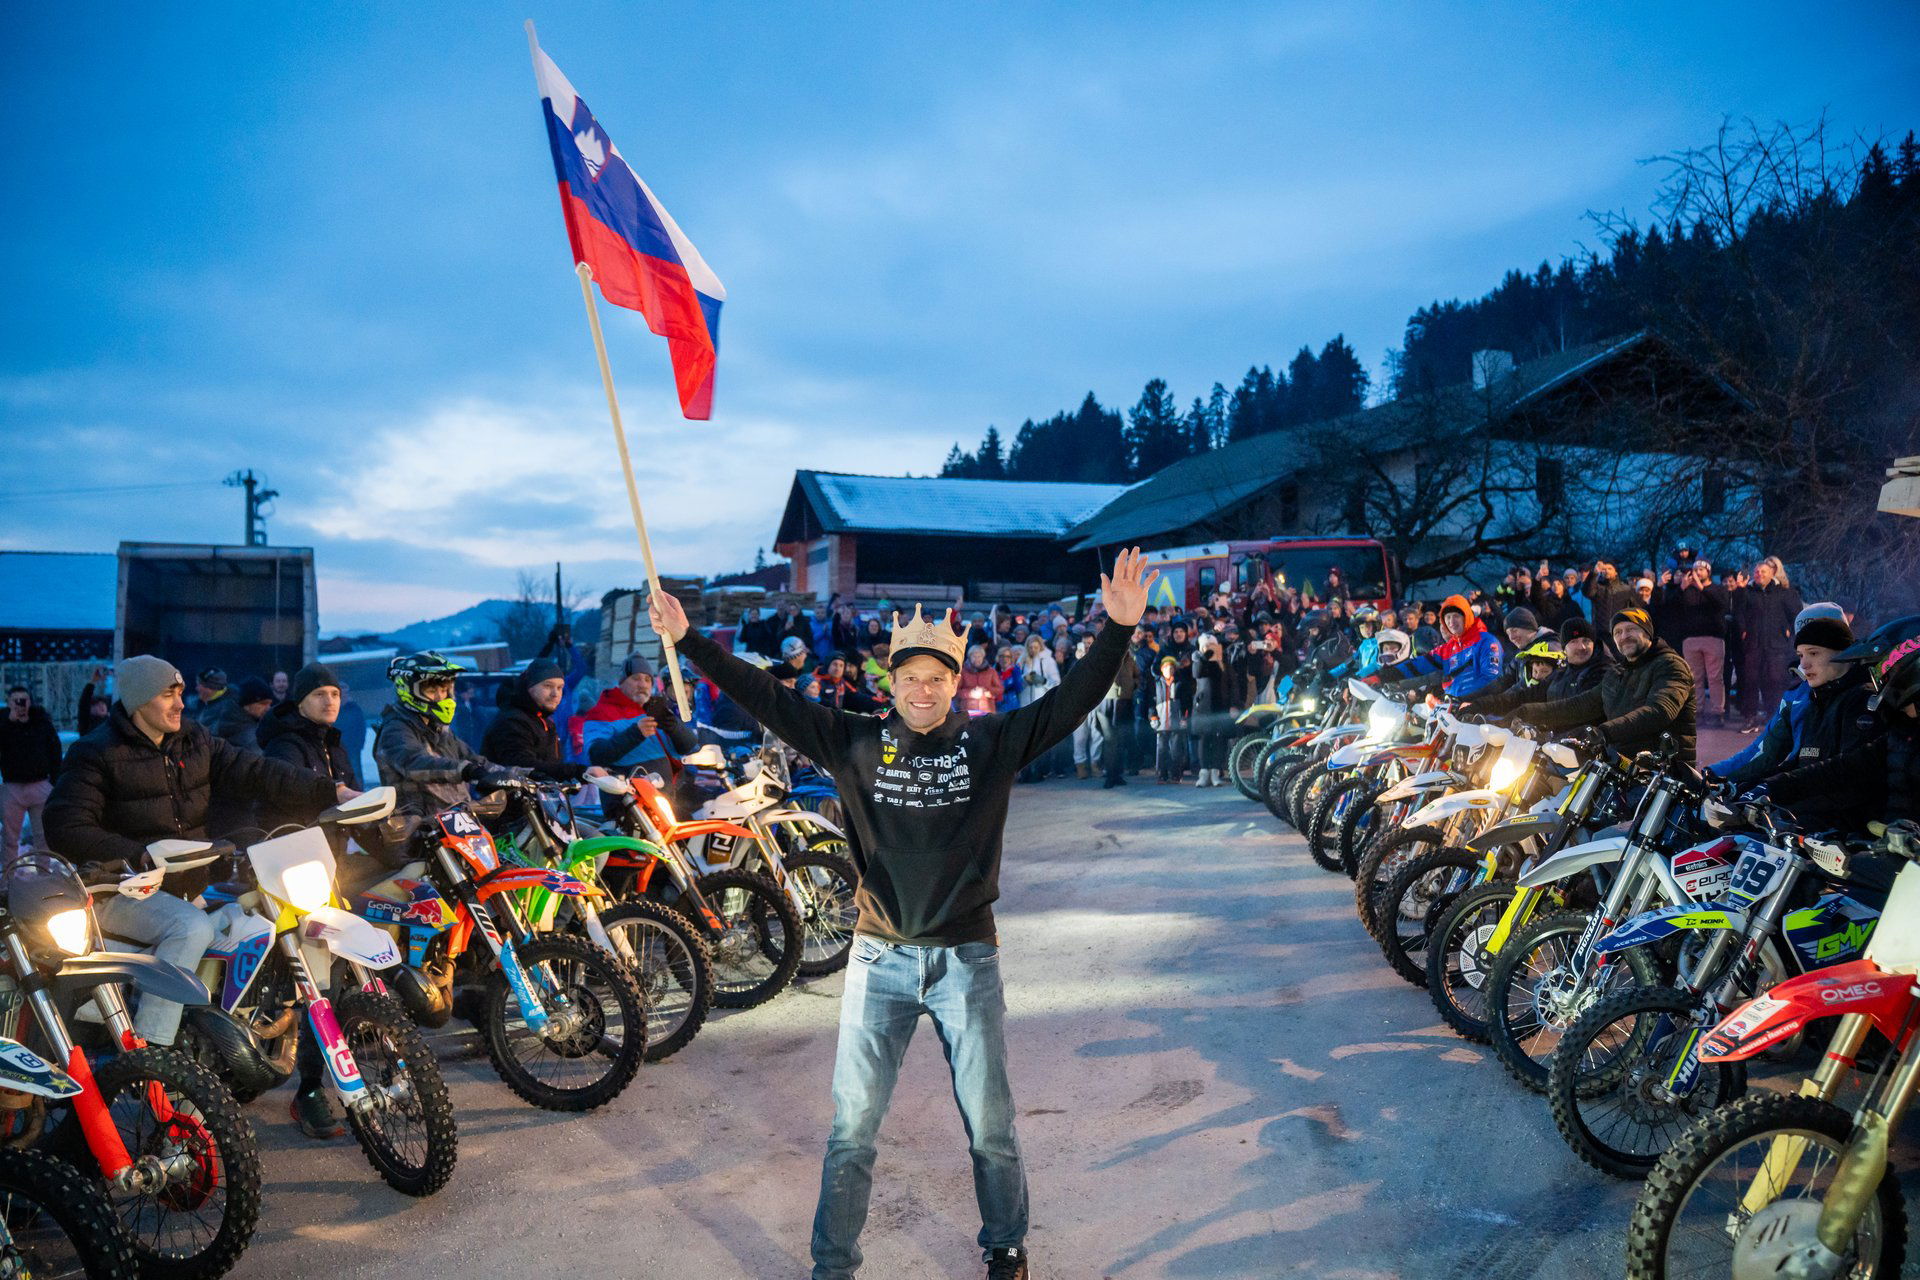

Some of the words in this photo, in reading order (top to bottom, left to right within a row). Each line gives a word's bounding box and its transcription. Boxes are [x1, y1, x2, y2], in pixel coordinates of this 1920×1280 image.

[1730, 856, 1777, 896] 39
[368, 901, 402, 913] GoPro
[1577, 910, 1600, 956] DUNLOP
[1817, 919, 1878, 959] GMV
[1821, 982, 1881, 1001] OMEC
[1768, 1021, 1800, 1042] Racing
